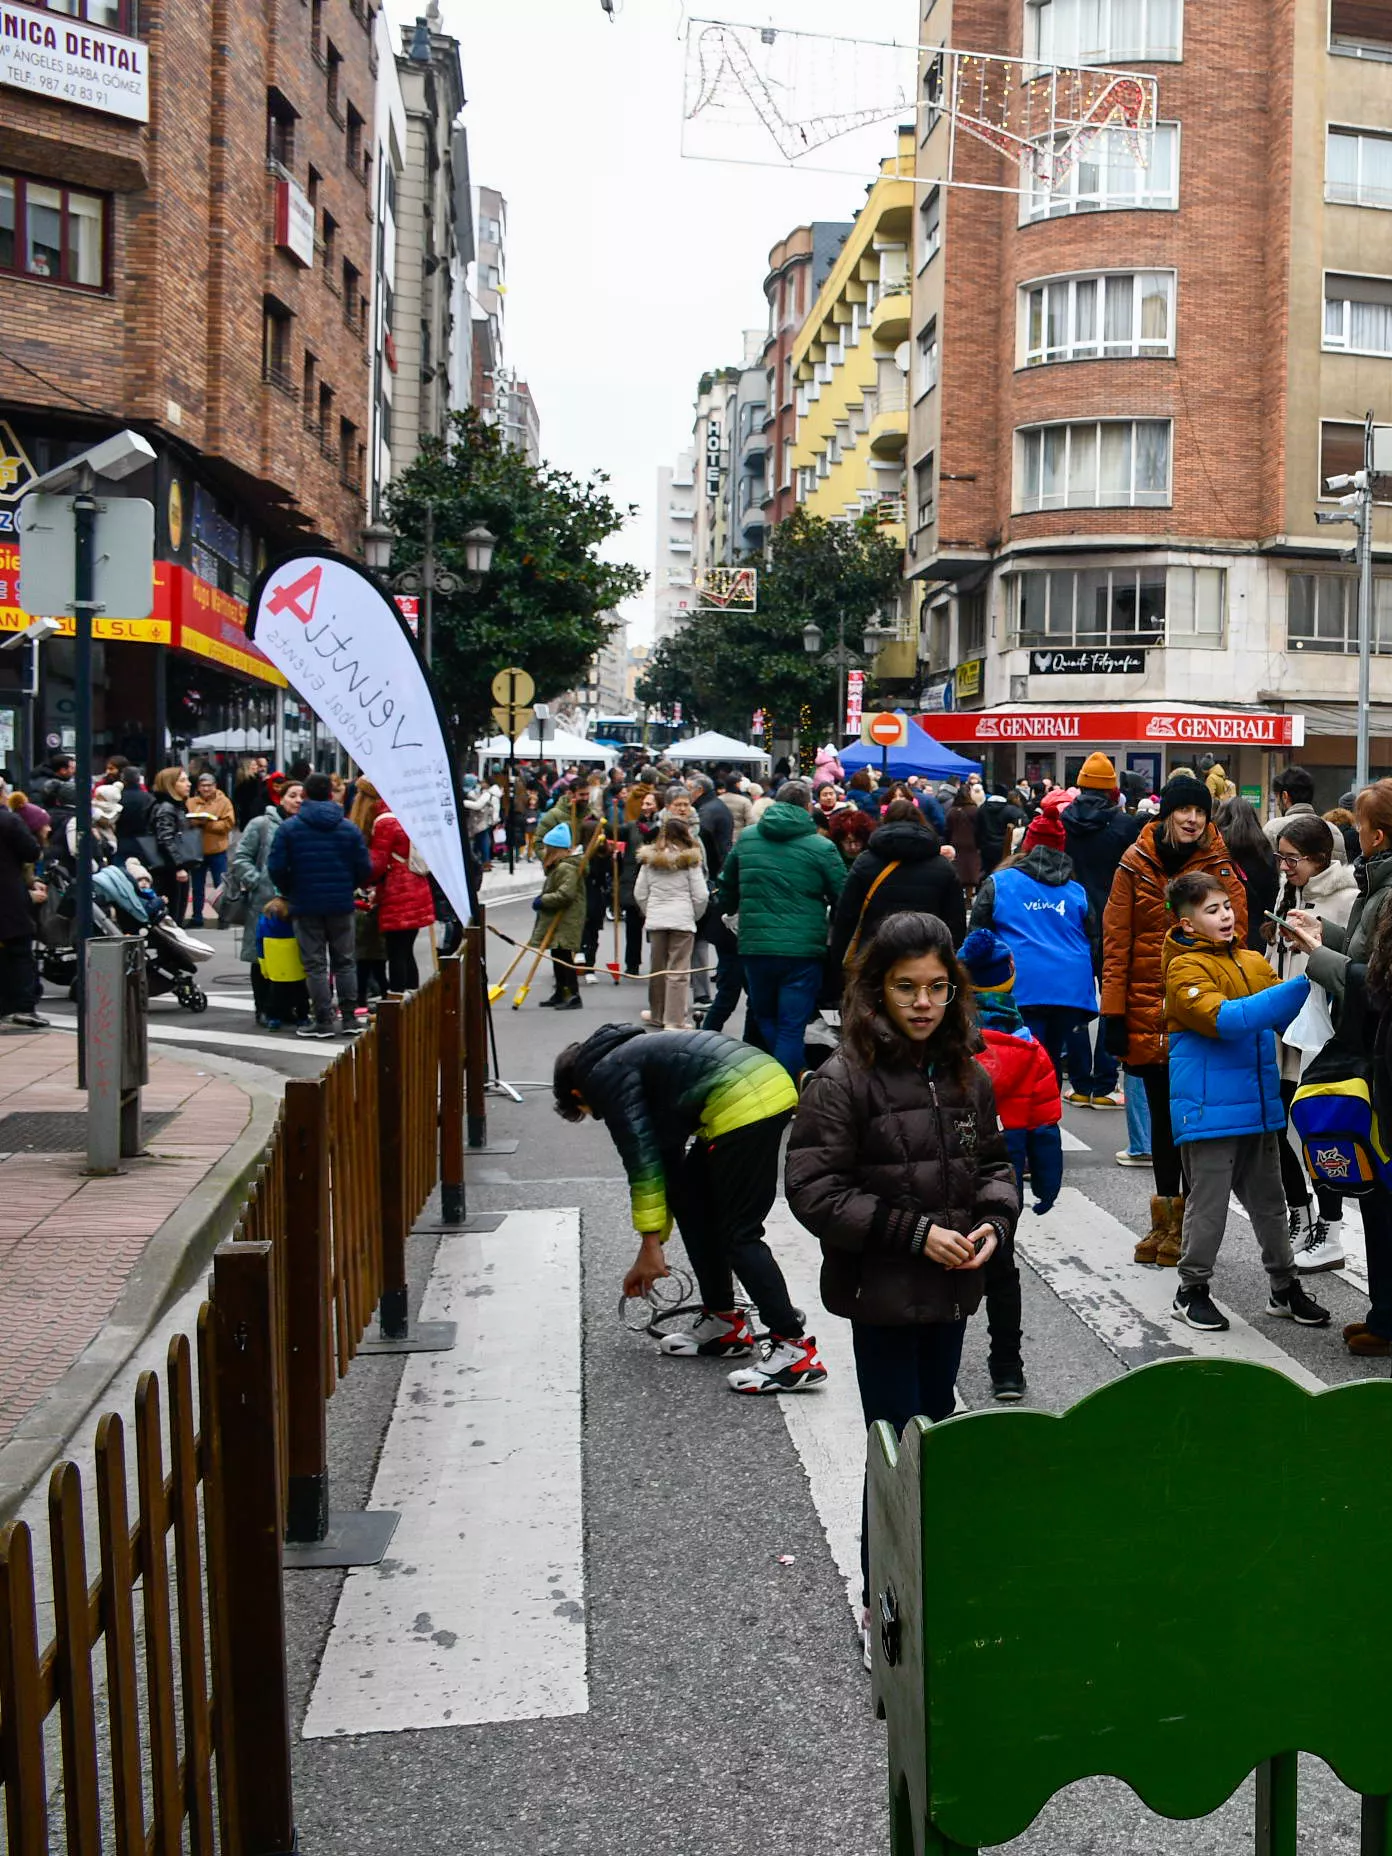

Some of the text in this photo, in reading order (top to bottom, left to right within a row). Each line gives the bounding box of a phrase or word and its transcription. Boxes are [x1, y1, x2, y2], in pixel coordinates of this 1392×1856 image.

[13, 44, 63, 73] ÁNGELES
[66, 62, 99, 81] BARBA
[102, 73, 142, 95] GÓMEZ
[66, 31, 141, 74] DENTAL
[40, 75, 59, 92] 987
[63, 83, 76, 96] 42
[80, 86, 93, 101] 83
[96, 91, 108, 105] 91
[707, 421, 720, 496] HOTEL
[1000, 717, 1079, 737] GENERALI
[1177, 718, 1275, 739] GENERALI
